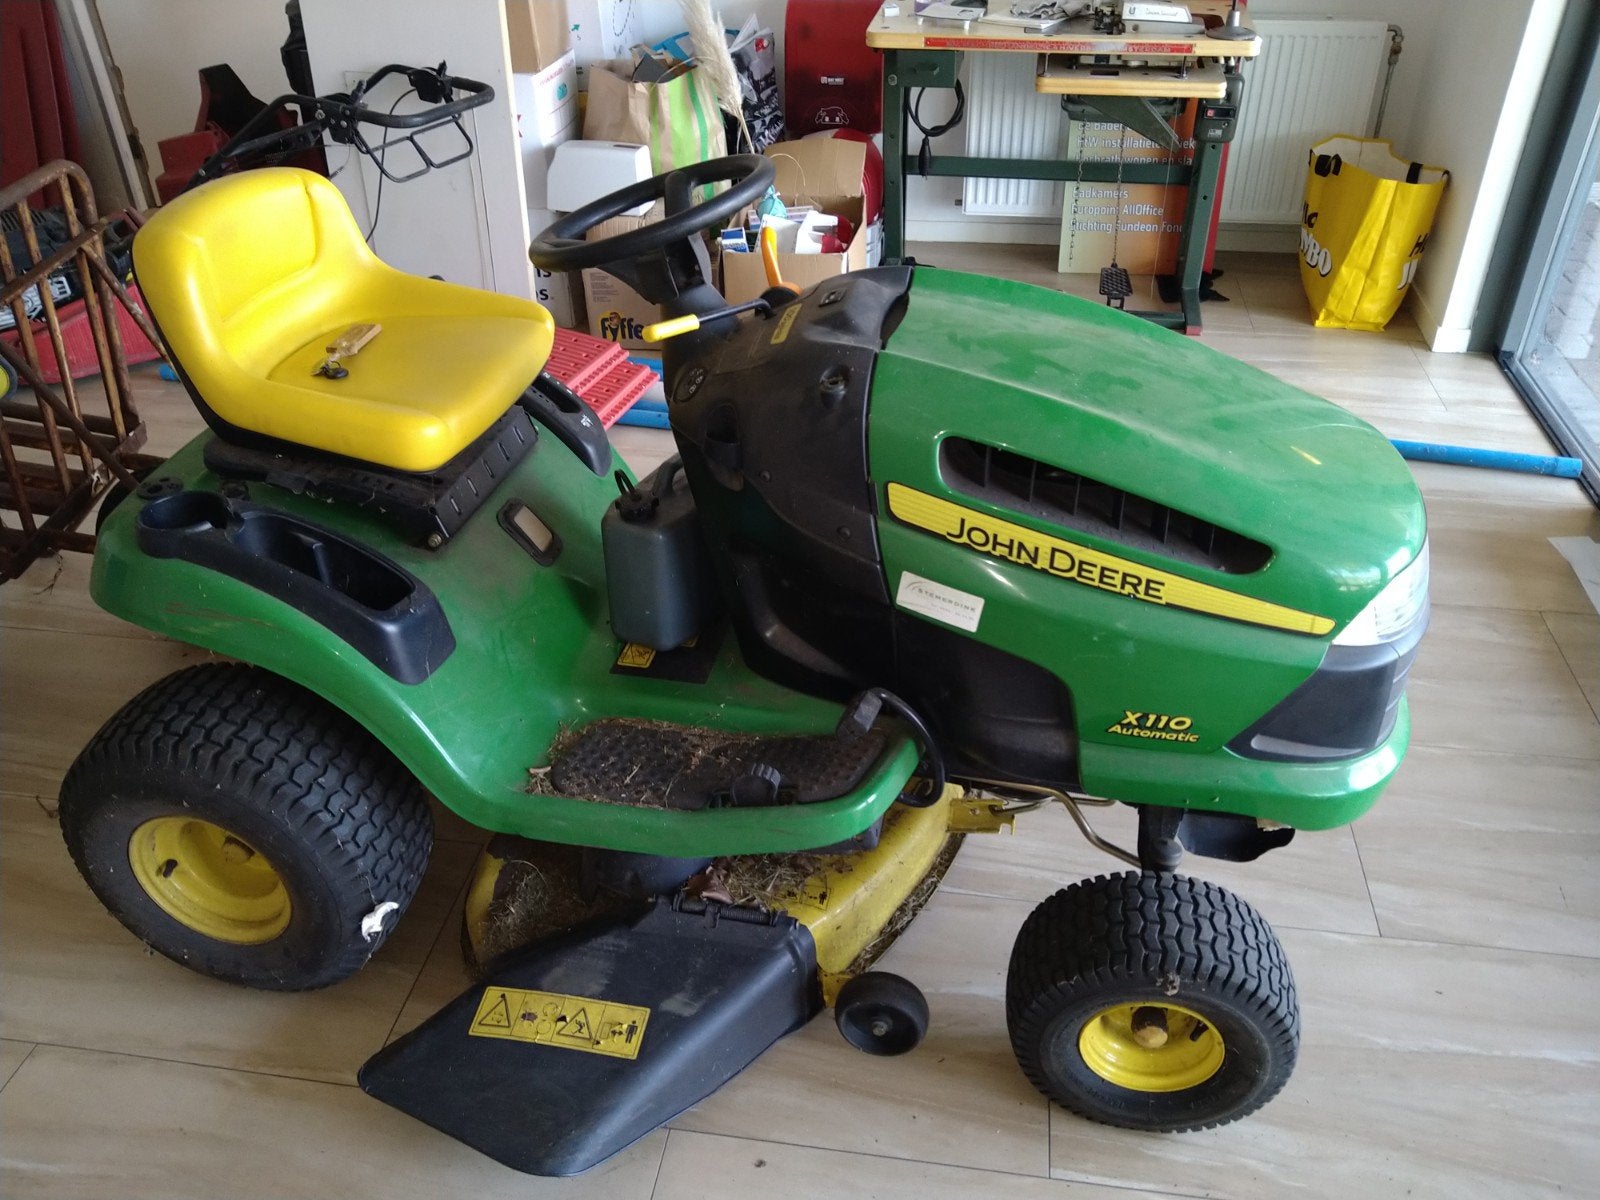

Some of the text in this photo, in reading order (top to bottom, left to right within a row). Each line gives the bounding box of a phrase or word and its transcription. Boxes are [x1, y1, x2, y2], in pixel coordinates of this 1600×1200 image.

[1122, 204, 1164, 216] AllOffice
[601, 317, 645, 342] Fyffe
[946, 517, 1165, 600] JOHN DEERE
[1121, 710, 1192, 731] X110
[1107, 724, 1199, 743] Automatic
